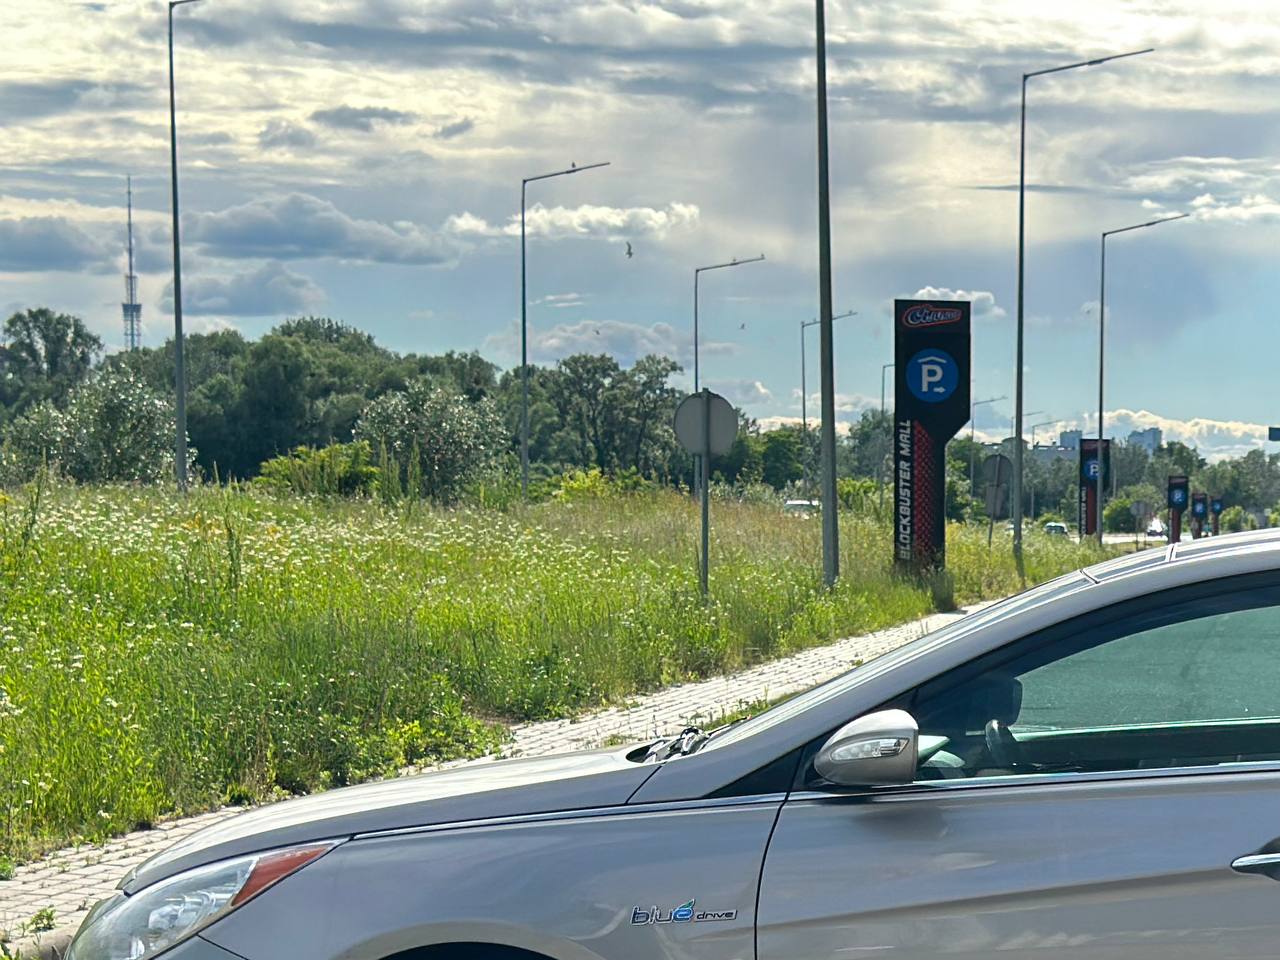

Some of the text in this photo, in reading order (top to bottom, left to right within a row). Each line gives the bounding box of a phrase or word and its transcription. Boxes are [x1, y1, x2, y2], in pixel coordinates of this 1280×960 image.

[921, 364, 944, 392] P
[899, 419, 911, 560] BLOCKBUSTER MALL
[631, 899, 735, 925] blue drive
